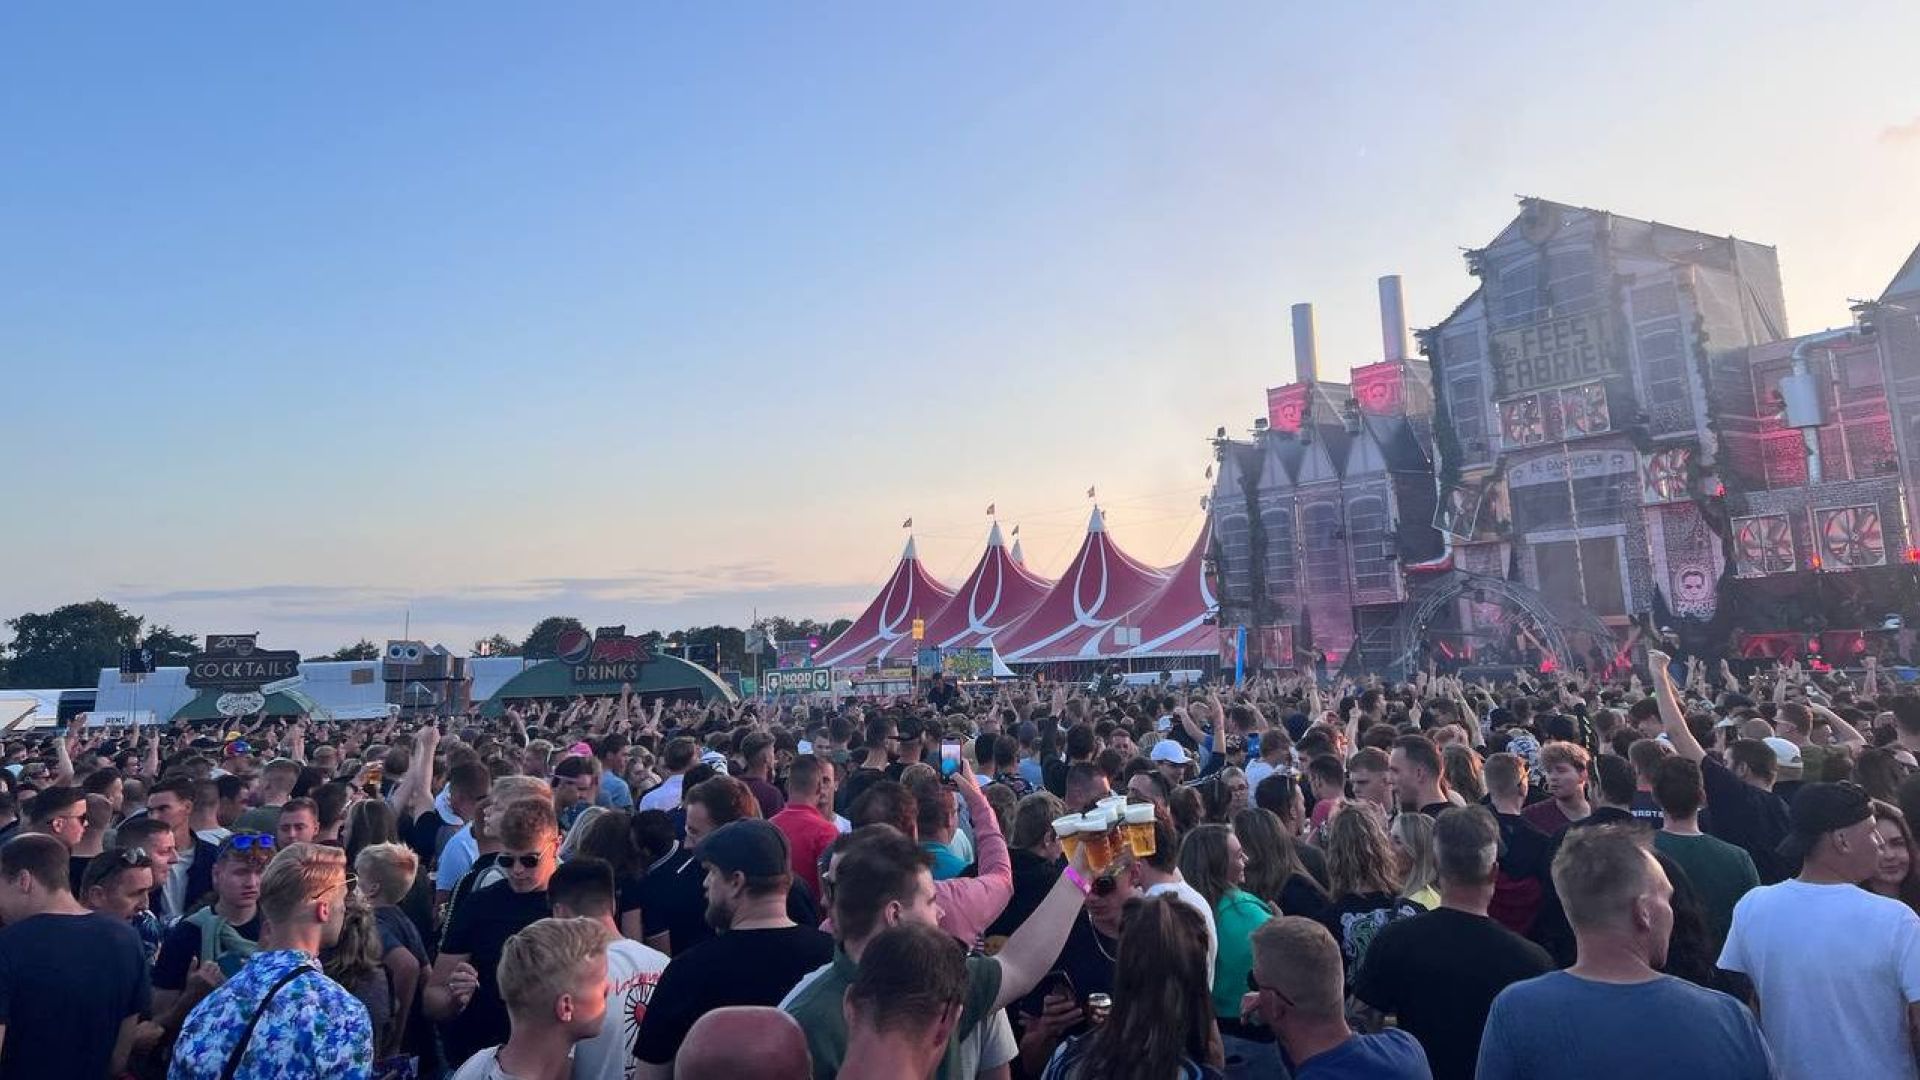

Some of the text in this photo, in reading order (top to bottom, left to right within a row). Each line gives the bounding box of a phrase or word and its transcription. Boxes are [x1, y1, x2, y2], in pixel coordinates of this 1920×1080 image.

[193, 661, 292, 678] COCKTAILS
[574, 664, 638, 681] DRINKS
[782, 672, 812, 684] NOOD
